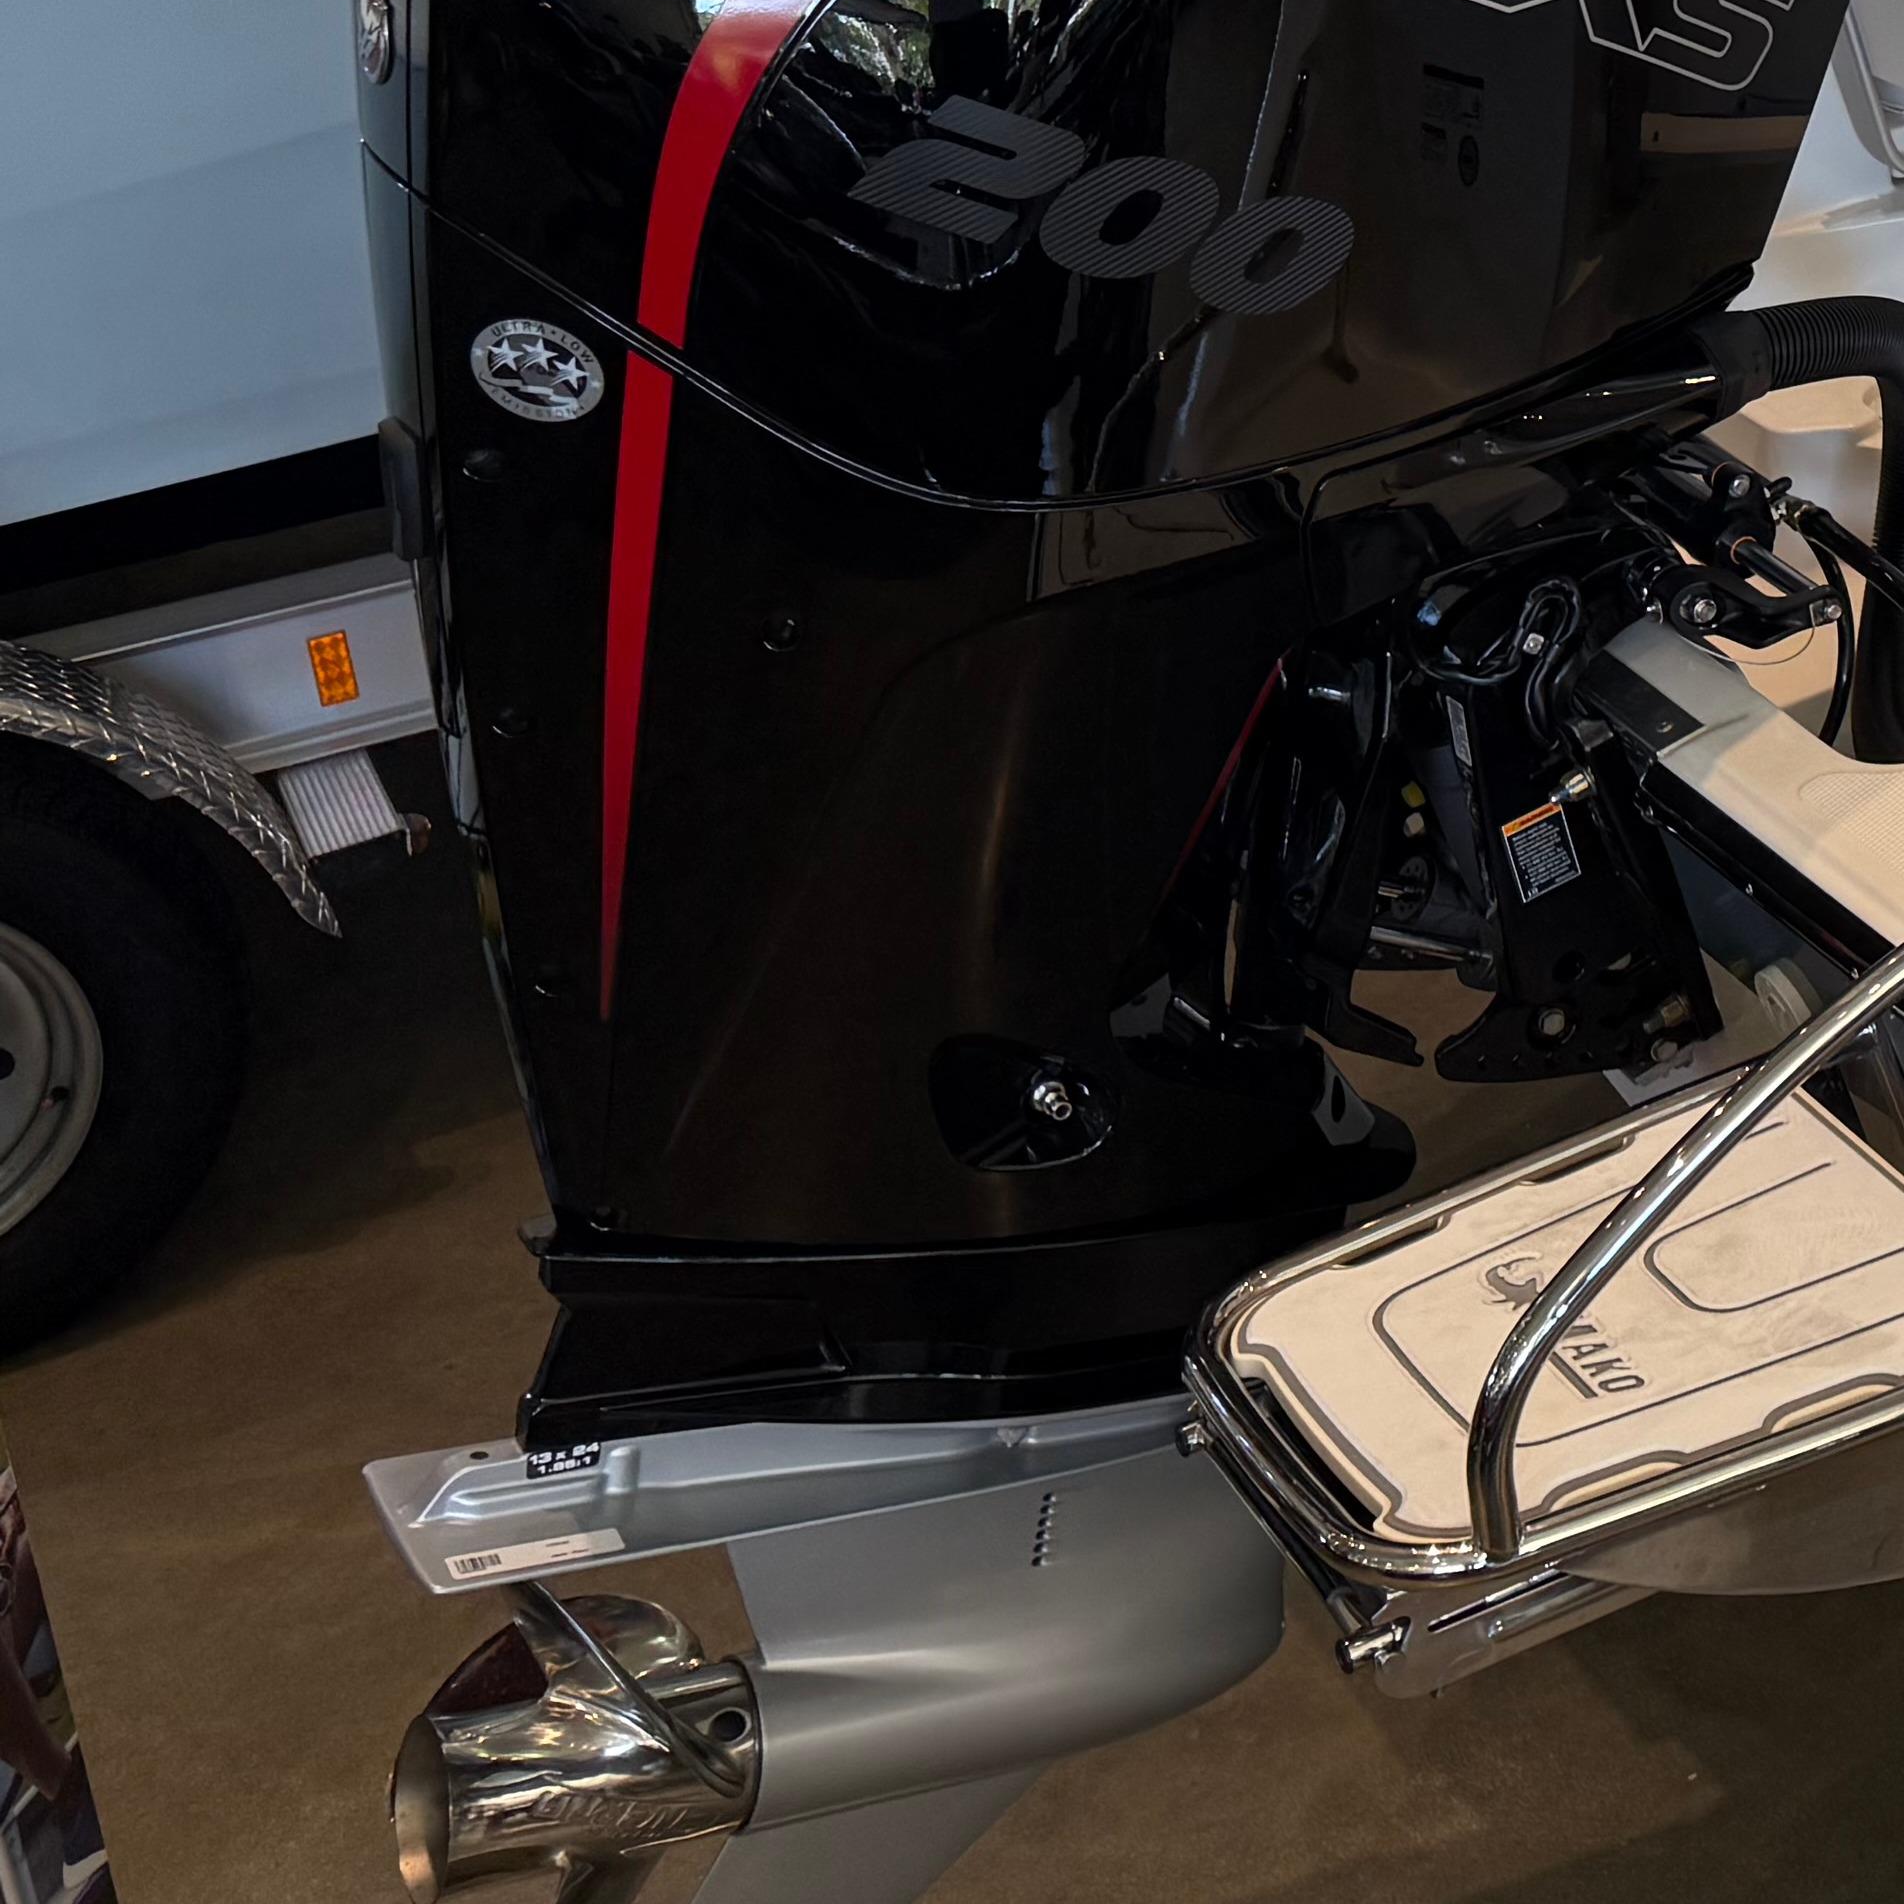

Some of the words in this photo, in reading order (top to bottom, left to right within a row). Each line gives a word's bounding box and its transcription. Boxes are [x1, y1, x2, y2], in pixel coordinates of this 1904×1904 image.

[847, 94, 1355, 315] 200
[491, 319, 546, 338] ULTRA
[560, 334, 594, 363] LOW
[528, 1451, 553, 1466] 13
[572, 1441, 600, 1457] 24
